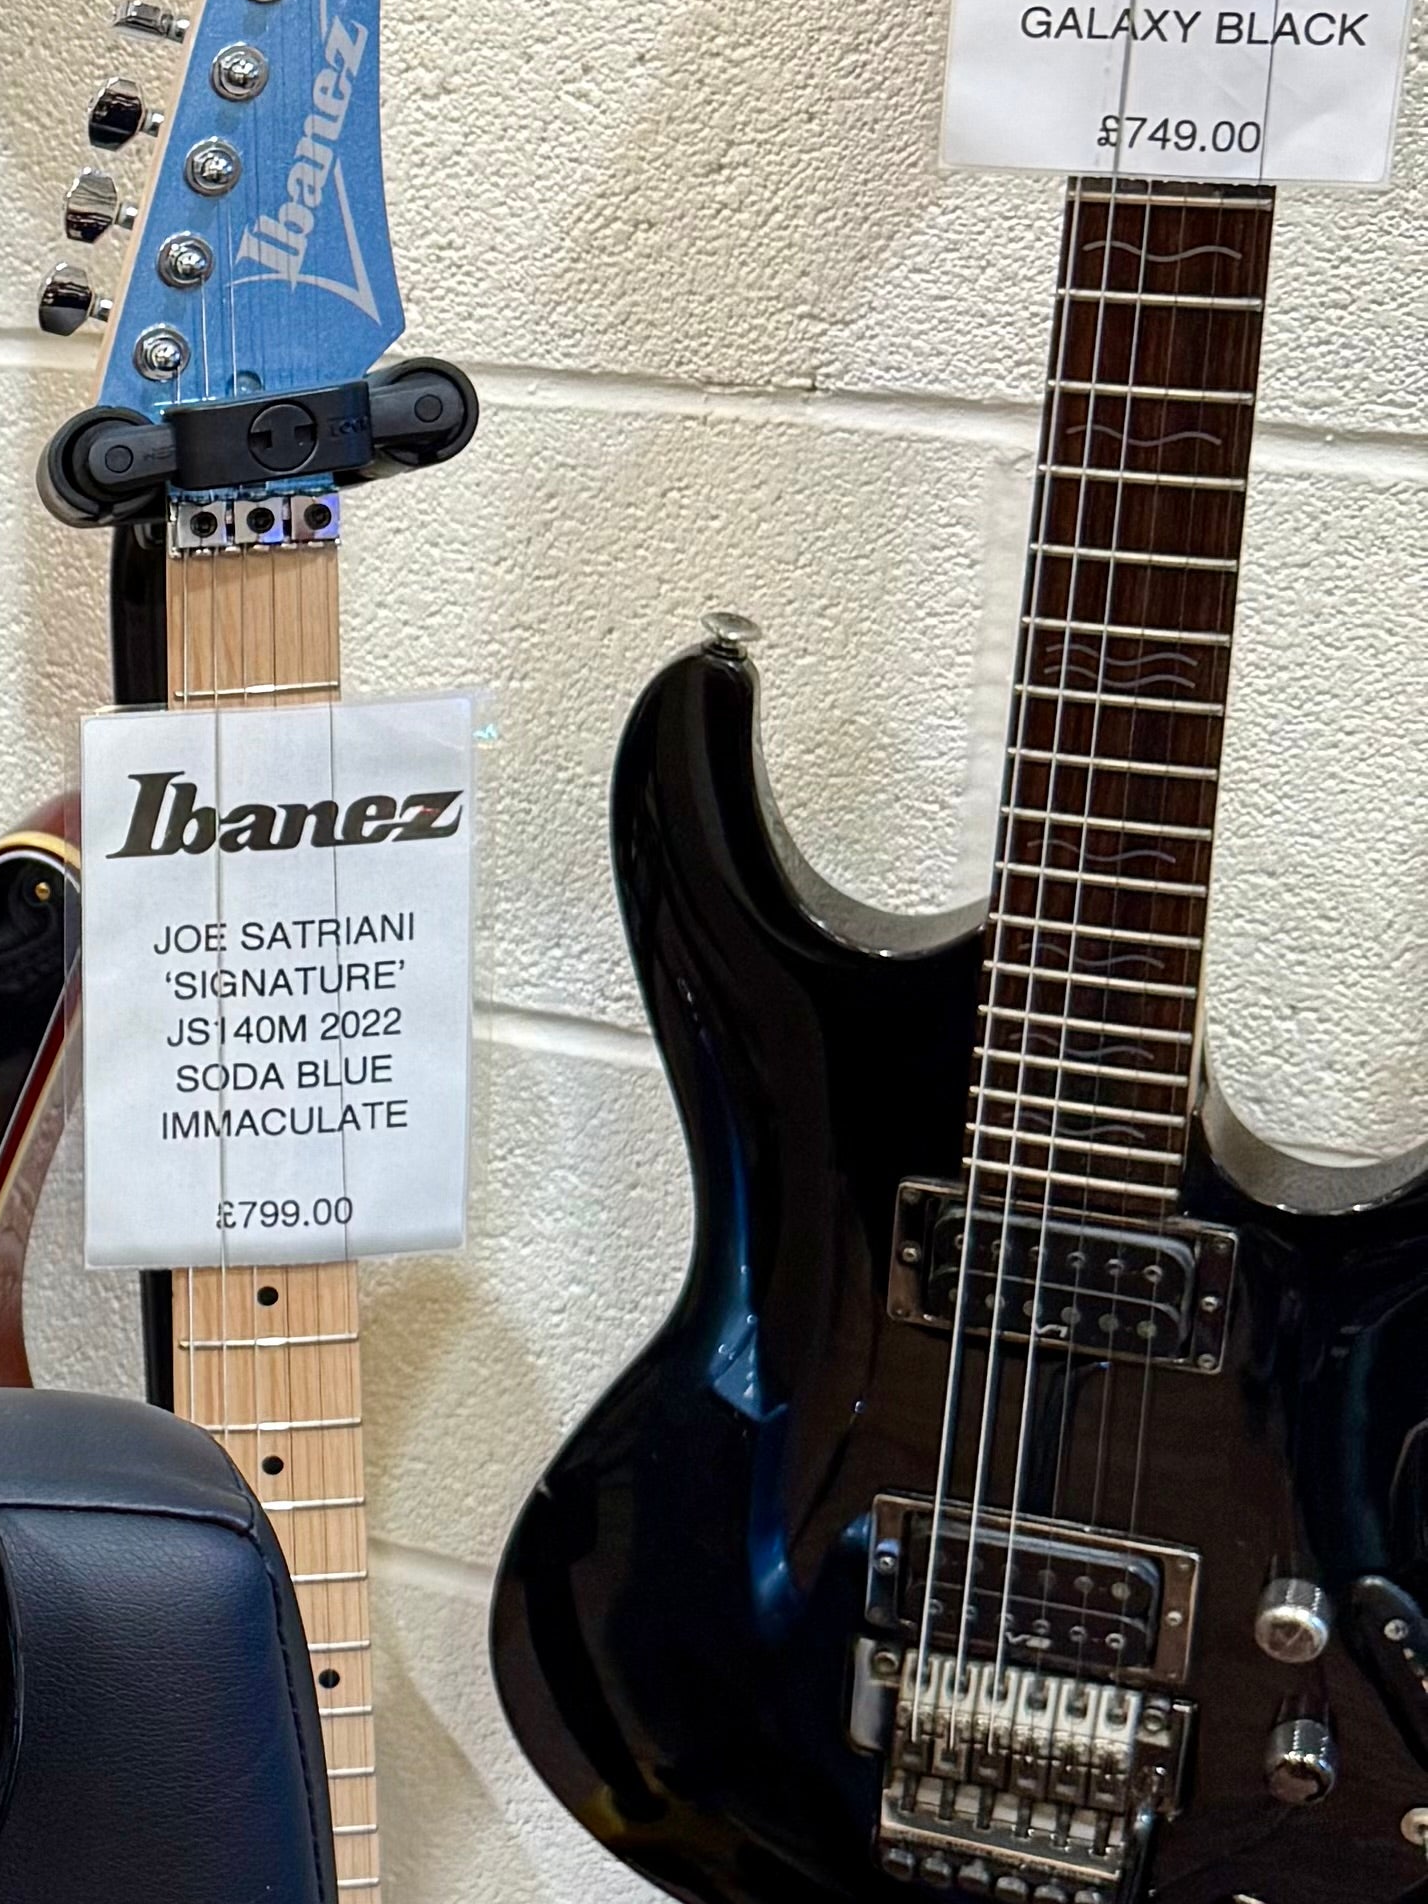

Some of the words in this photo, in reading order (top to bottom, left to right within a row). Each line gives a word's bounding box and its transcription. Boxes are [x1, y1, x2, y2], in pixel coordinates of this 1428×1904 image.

[1020, 7, 1200, 43] GALAXY
[1215, 12, 1369, 46] BLACK
[235, 16, 367, 290] Ibanez
[1097, 115, 1262, 154] £749.00
[105, 771, 464, 859] Ibanez
[153, 923, 226, 955] JOE
[240, 912, 415, 951] SATRIANI
[167, 1015, 307, 1047] JS140M
[320, 1009, 401, 1040] 2022
[176, 1062, 285, 1094] SODA
[297, 1054, 393, 1088] BLUE
[161, 1100, 408, 1139] IMMACULATE
[216, 1197, 353, 1230] £799.00
